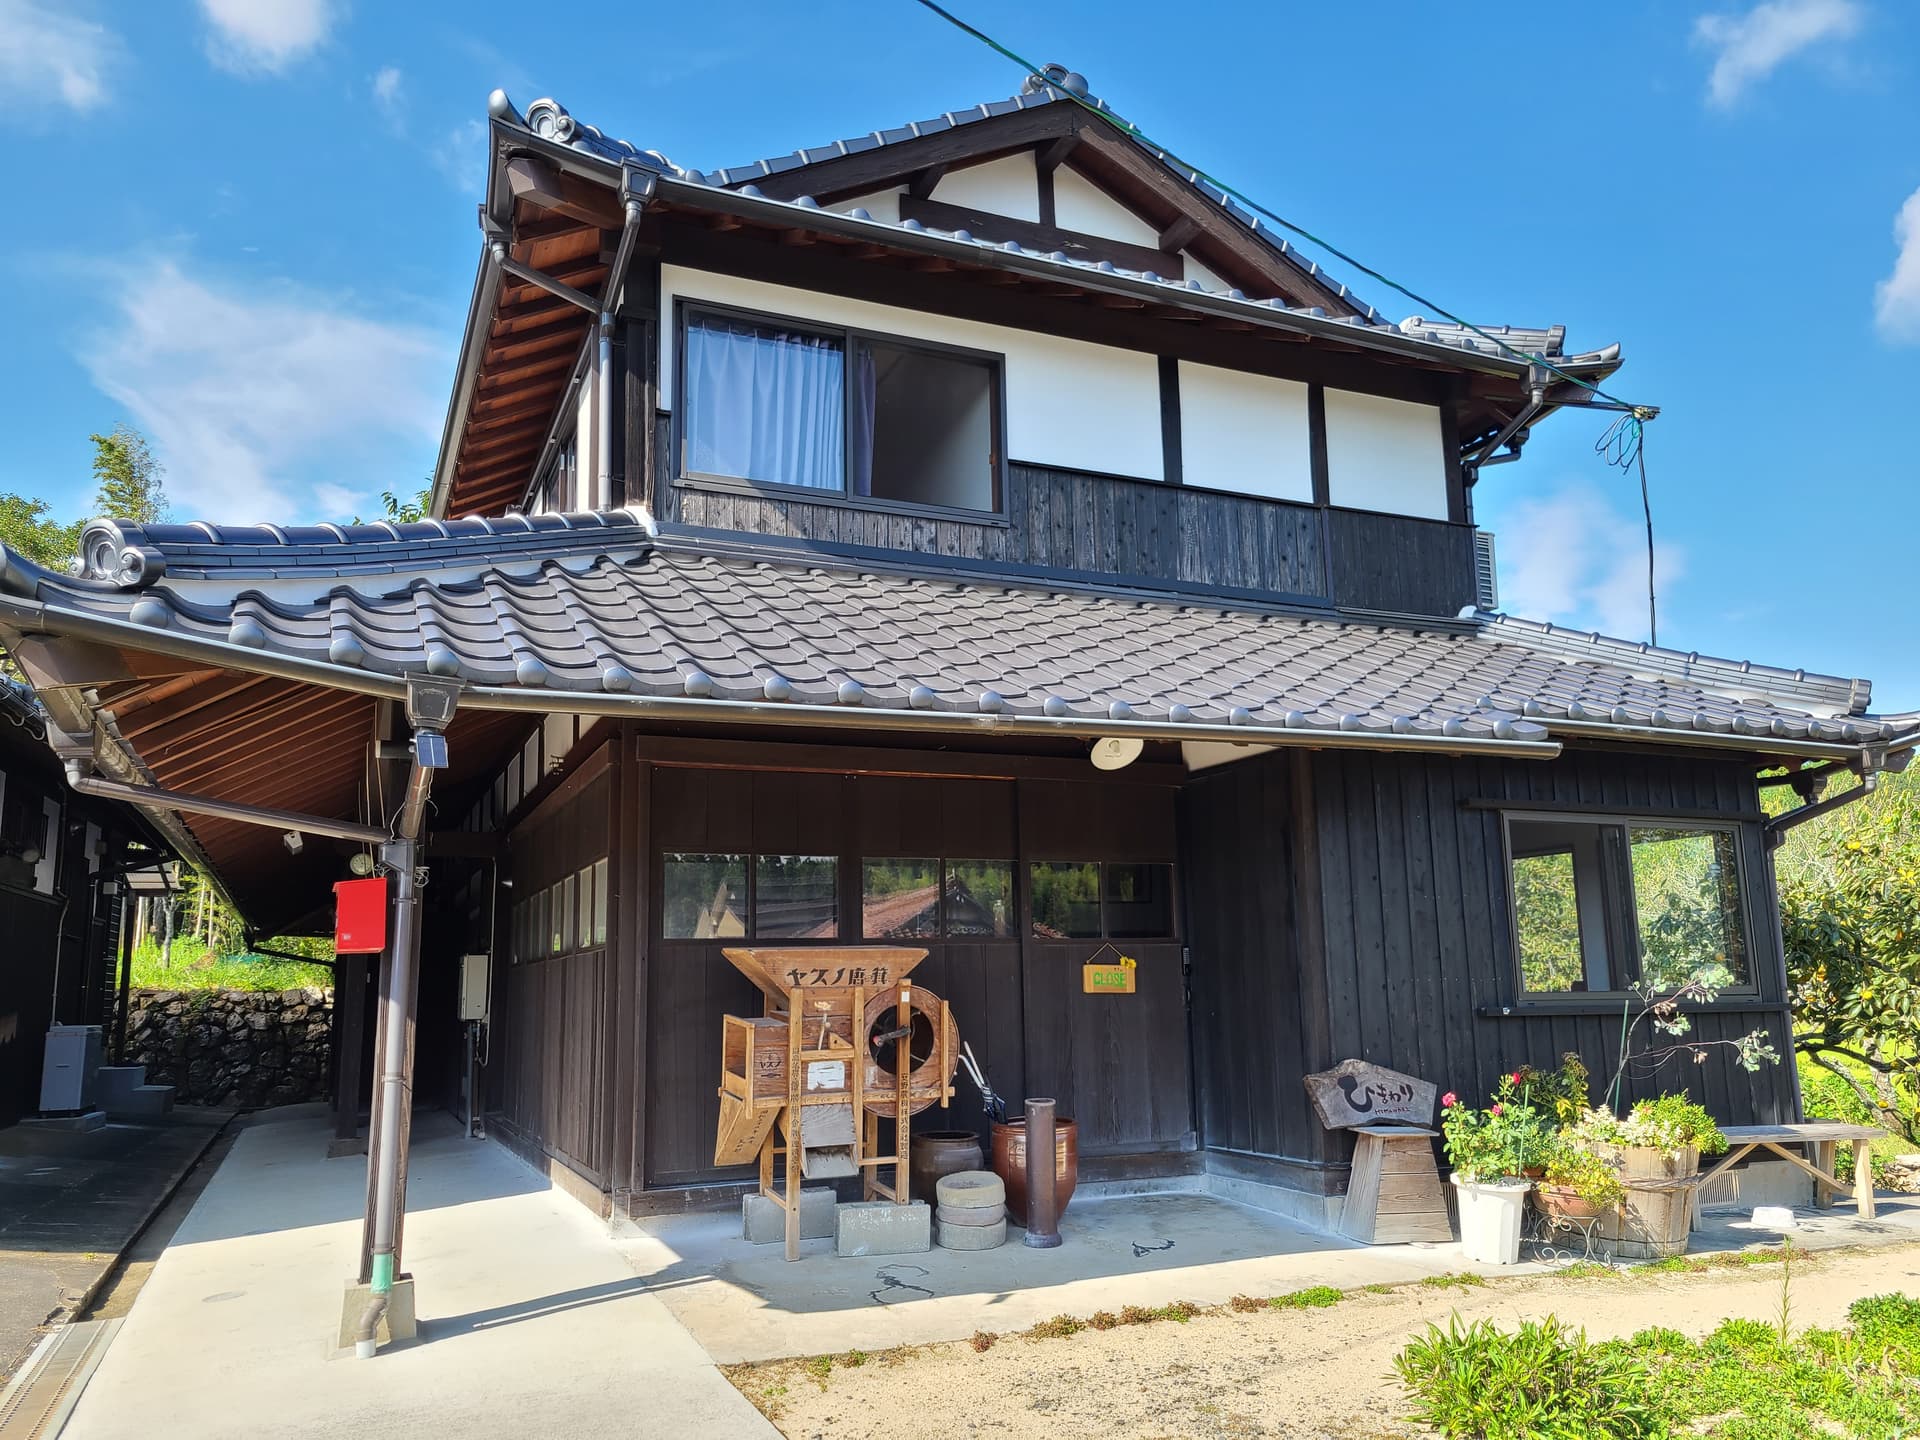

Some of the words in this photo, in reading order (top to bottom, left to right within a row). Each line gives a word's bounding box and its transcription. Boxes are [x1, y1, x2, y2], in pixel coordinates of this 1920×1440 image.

[1093, 972, 1126, 987] CLOSE
[1337, 1075, 1414, 1113] ひまわり
